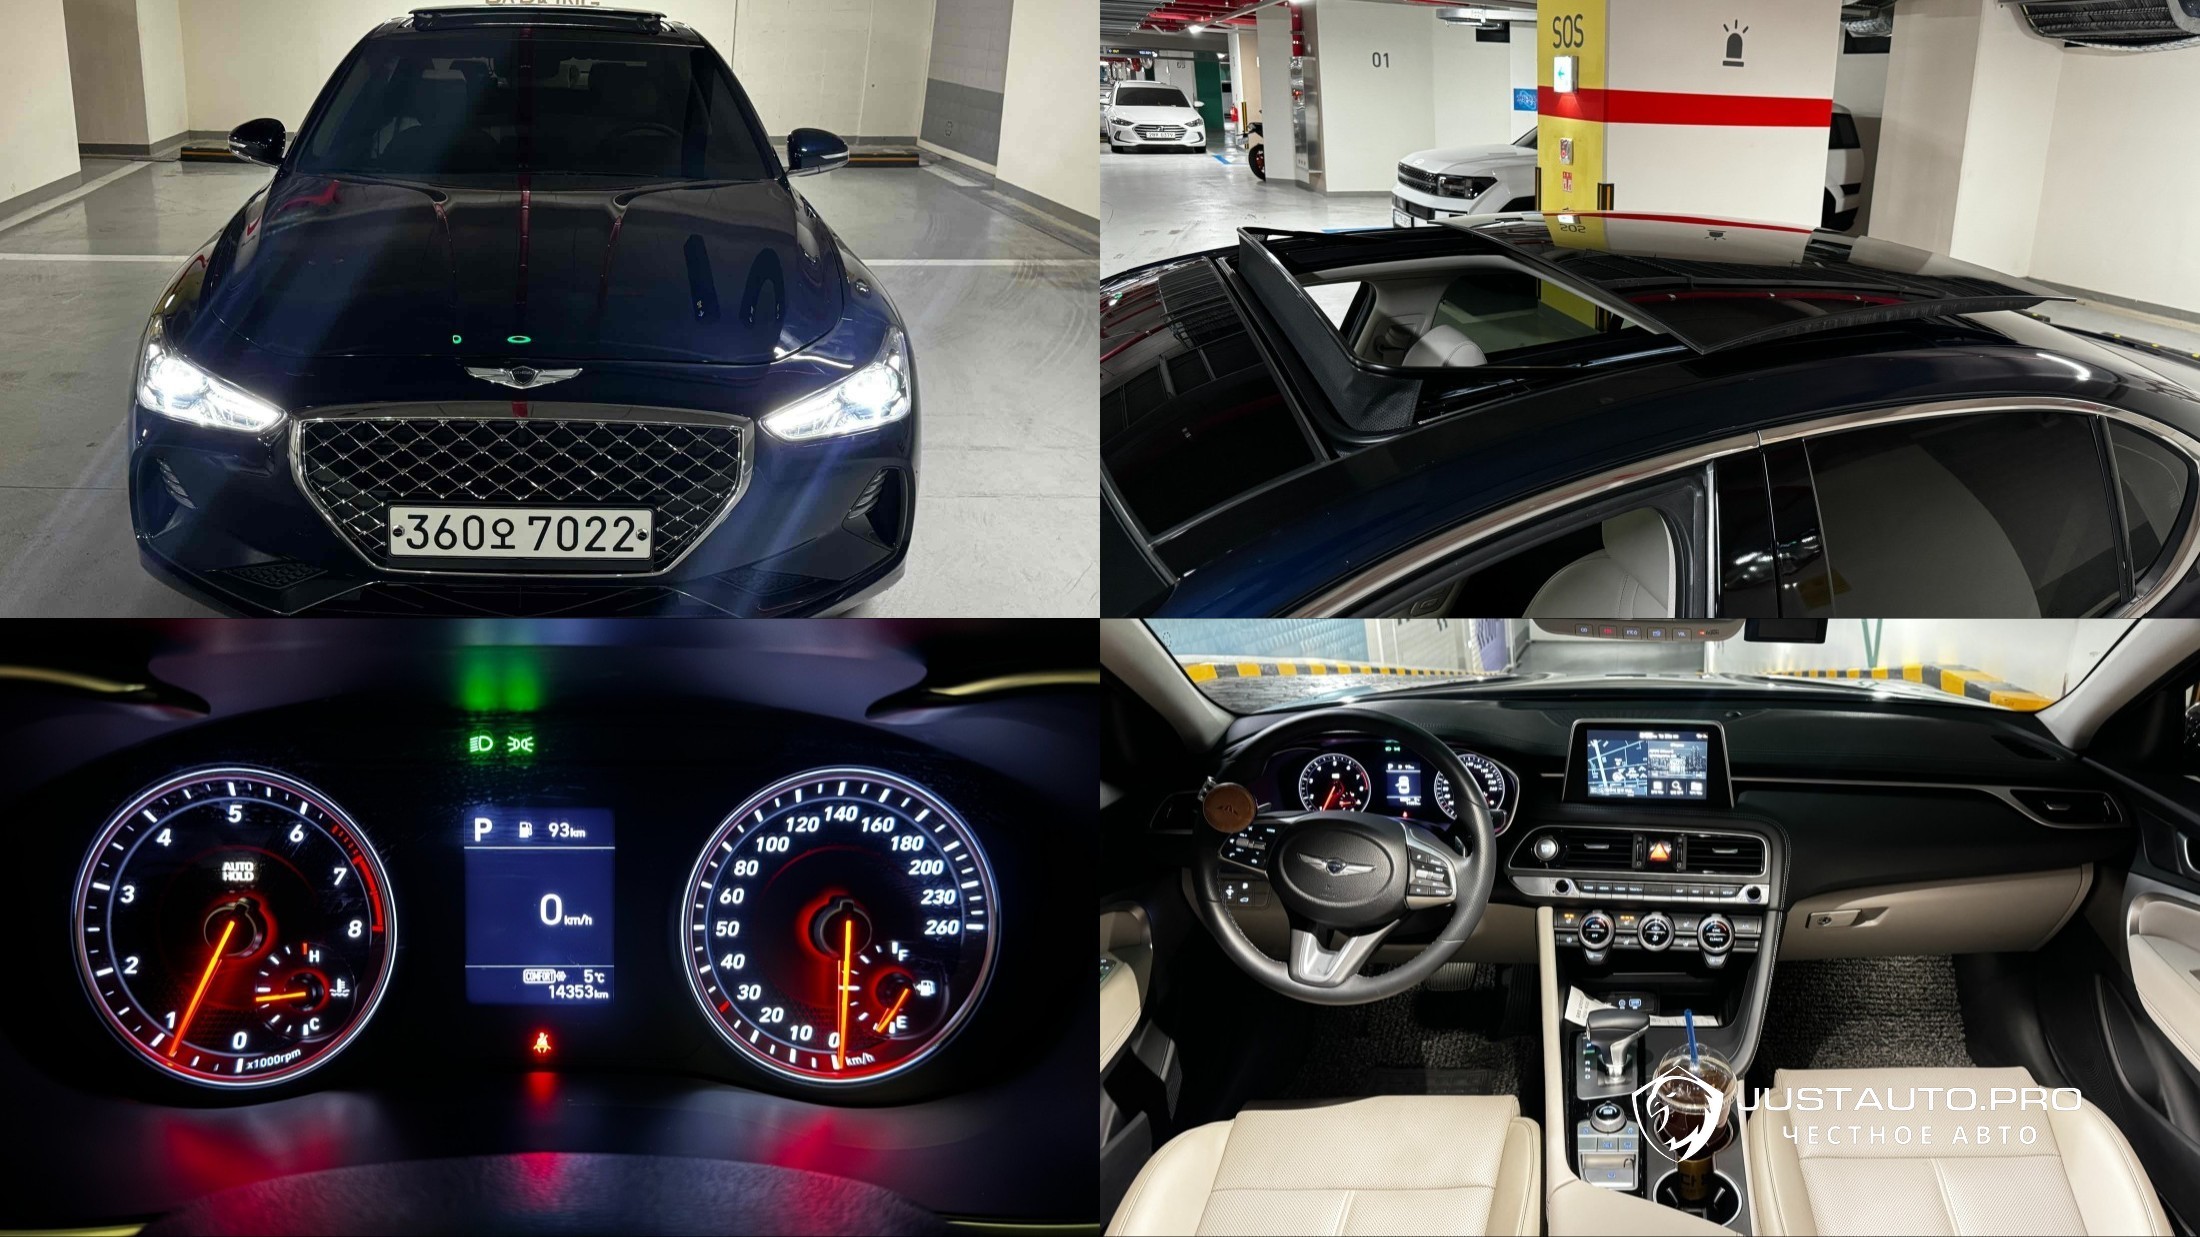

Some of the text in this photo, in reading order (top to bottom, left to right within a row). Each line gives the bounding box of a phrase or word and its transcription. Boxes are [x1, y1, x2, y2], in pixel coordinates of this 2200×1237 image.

[1552, 13, 1584, 49] SOS
[1371, 51, 1390, 69] 01
[406, 513, 636, 553] 360오 7022
[227, 804, 243, 824] 5
[824, 805, 859, 822] 140
[289, 823, 304, 843] 6
[474, 817, 493, 843] P
[786, 816, 820, 833] 120
[861, 815, 895, 833] 160
[156, 828, 172, 847] 4
[756, 836, 790, 853] 100
[890, 835, 925, 852] 180
[222, 861, 255, 871] AUTO
[733, 859, 759, 877] 80
[908, 859, 944, 876] 200
[222, 871, 255, 882] HOLD
[333, 867, 348, 886] 7
[120, 884, 136, 904] 3
[719, 887, 745, 905] 60
[920, 888, 957, 906] 230
[347, 919, 363, 939] 8
[715, 920, 740, 938] 50
[924, 919, 960, 936] 260
[308, 949, 320, 963] H
[720, 953, 746, 970] 40
[898, 948, 909, 962] F
[123, 955, 139, 975] 2
[736, 983, 762, 1001] 30
[165, 1011, 176, 1029] 1
[309, 1017, 320, 1031] C
[758, 1006, 785, 1024] 20
[896, 1016, 907, 1029] E
[232, 1031, 248, 1050] 0
[789, 1024, 814, 1042] 10
[827, 1031, 840, 1049] 0
[245, 1049, 302, 1070] x1000rpm
[845, 1051, 876, 1067] km/h
